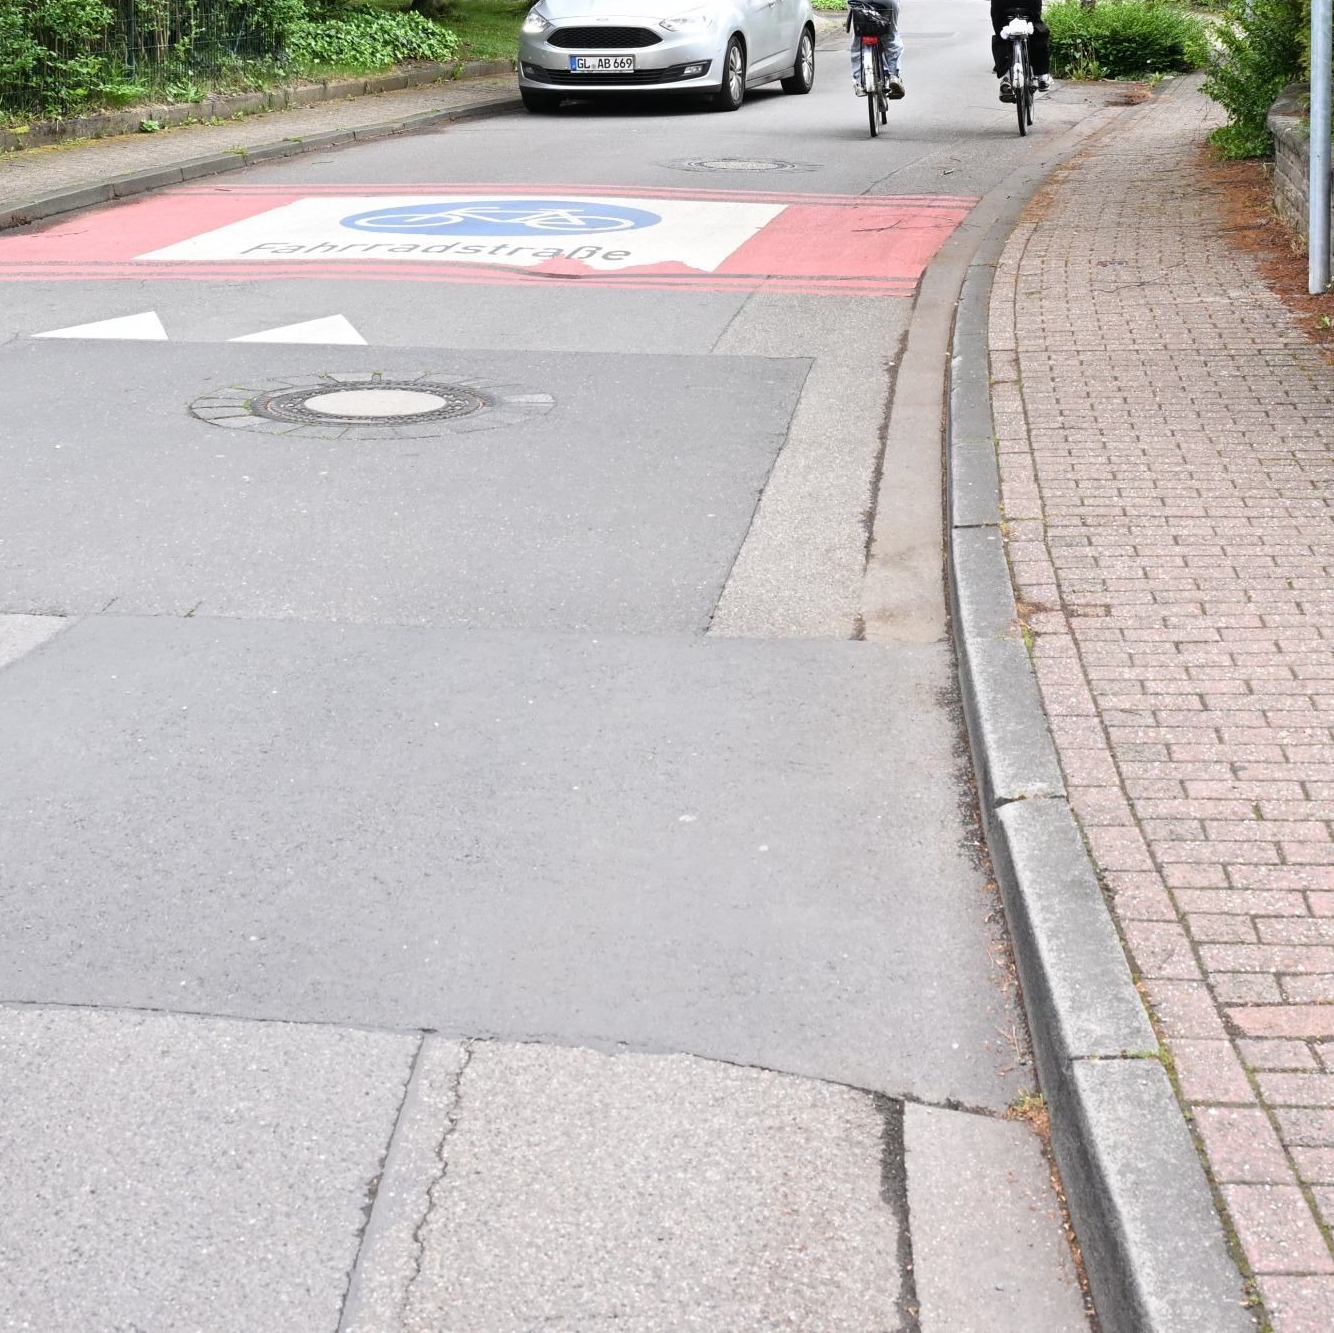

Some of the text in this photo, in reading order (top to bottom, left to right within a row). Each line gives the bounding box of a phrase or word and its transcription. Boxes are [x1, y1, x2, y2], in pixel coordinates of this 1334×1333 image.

[577, 58, 633, 69] GL AB 669
[240, 241, 632, 262] Fahrradstraße
